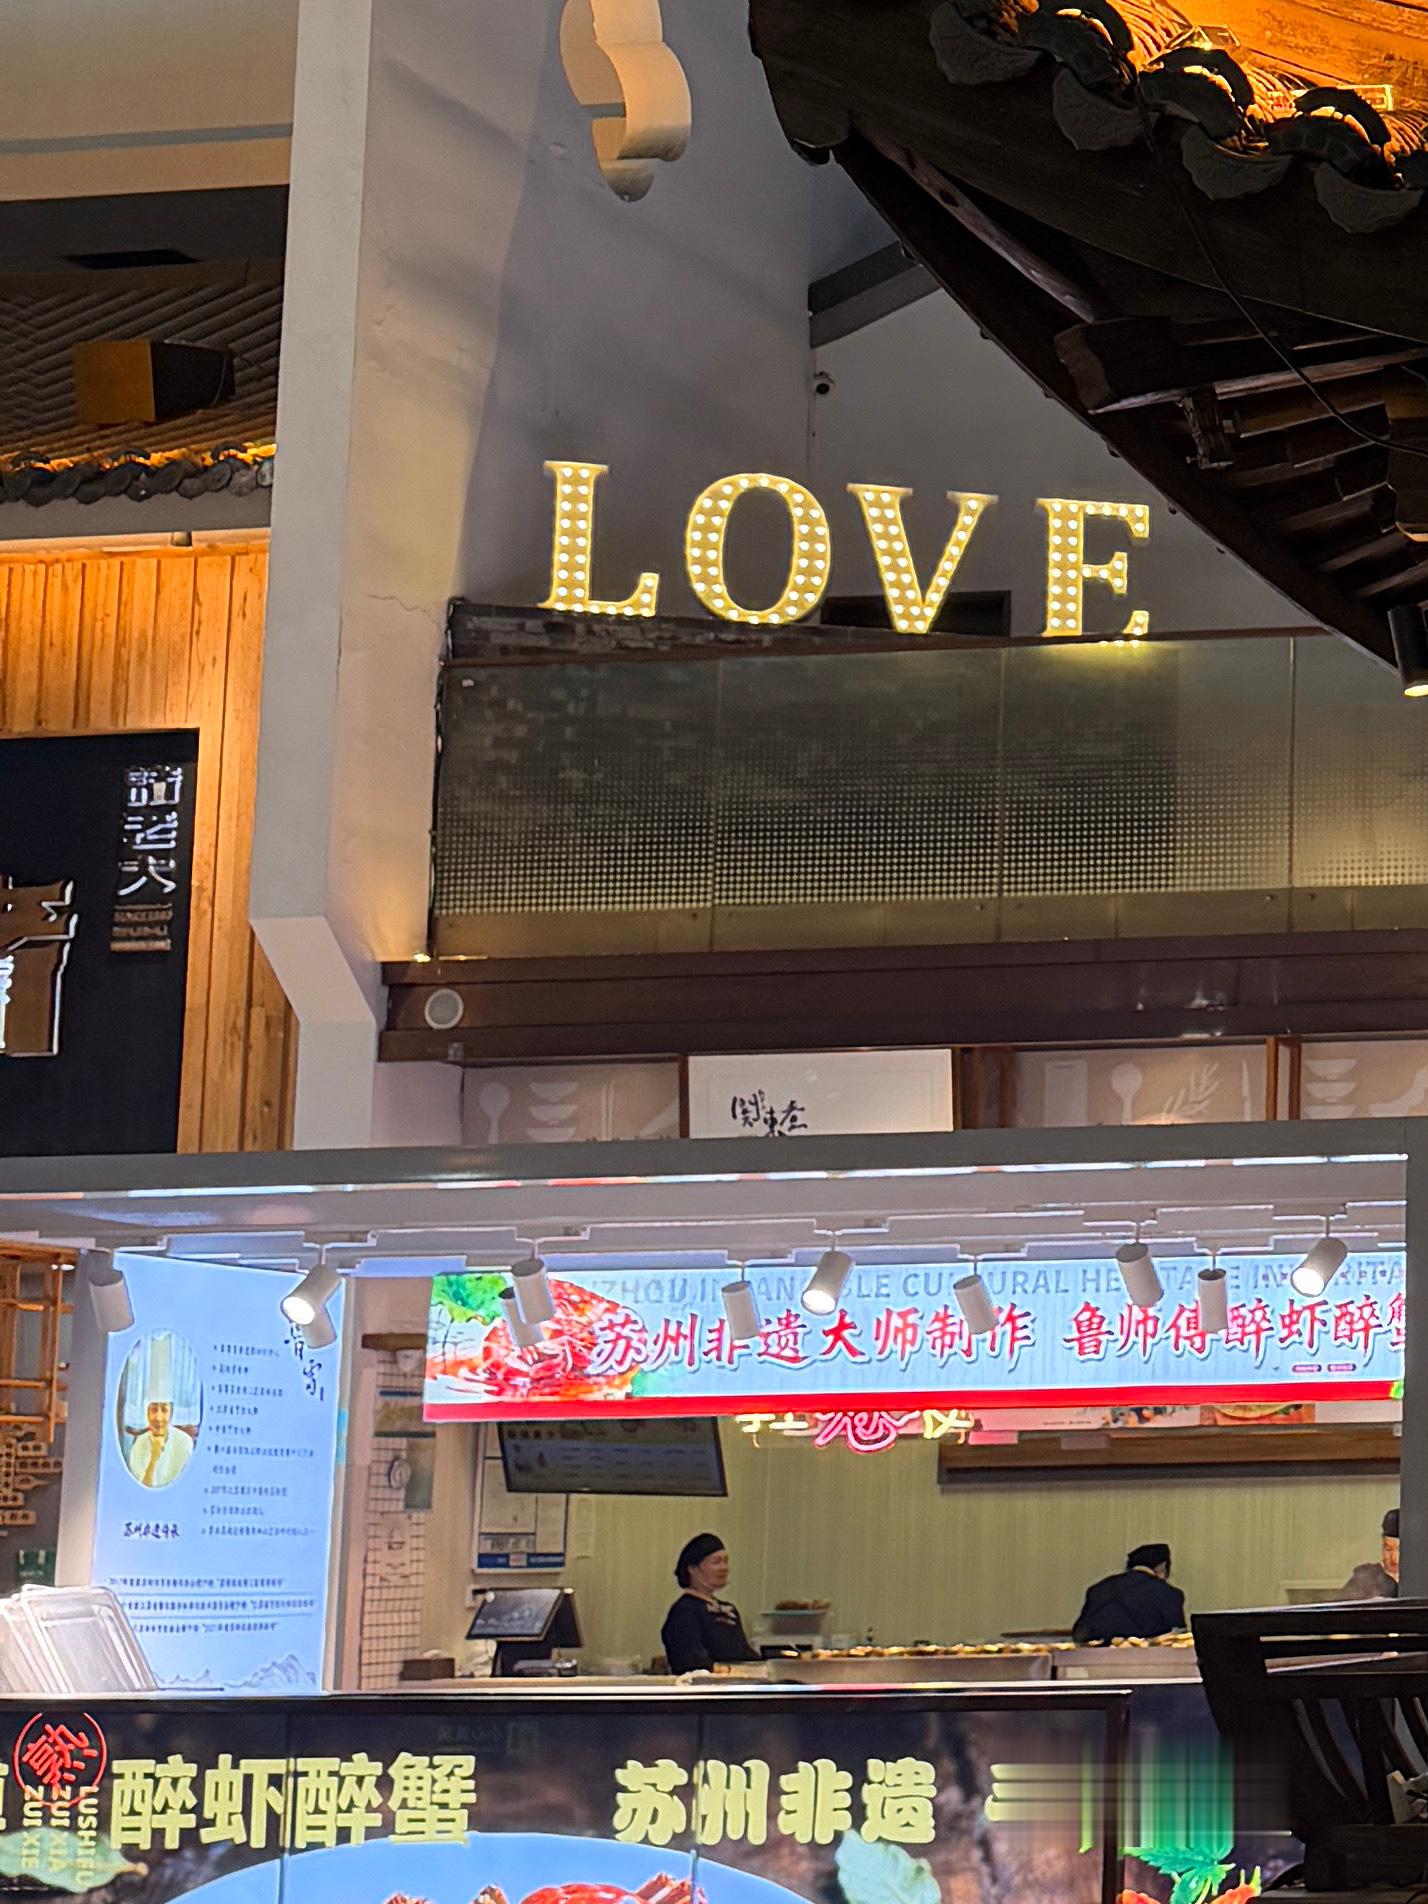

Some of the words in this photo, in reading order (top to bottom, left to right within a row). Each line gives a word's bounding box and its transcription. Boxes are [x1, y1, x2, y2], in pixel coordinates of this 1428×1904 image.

[537, 460, 1151, 647] LOVE
[902, 1268, 1069, 1298] CUURAL
[597, 1302, 1033, 1370] 苏州非遗大师制作
[23, 1784, 45, 1827] ZUI
[111, 1752, 476, 1850] 醉虾醉蟹
[612, 1757, 936, 1846] 苏州非遗
